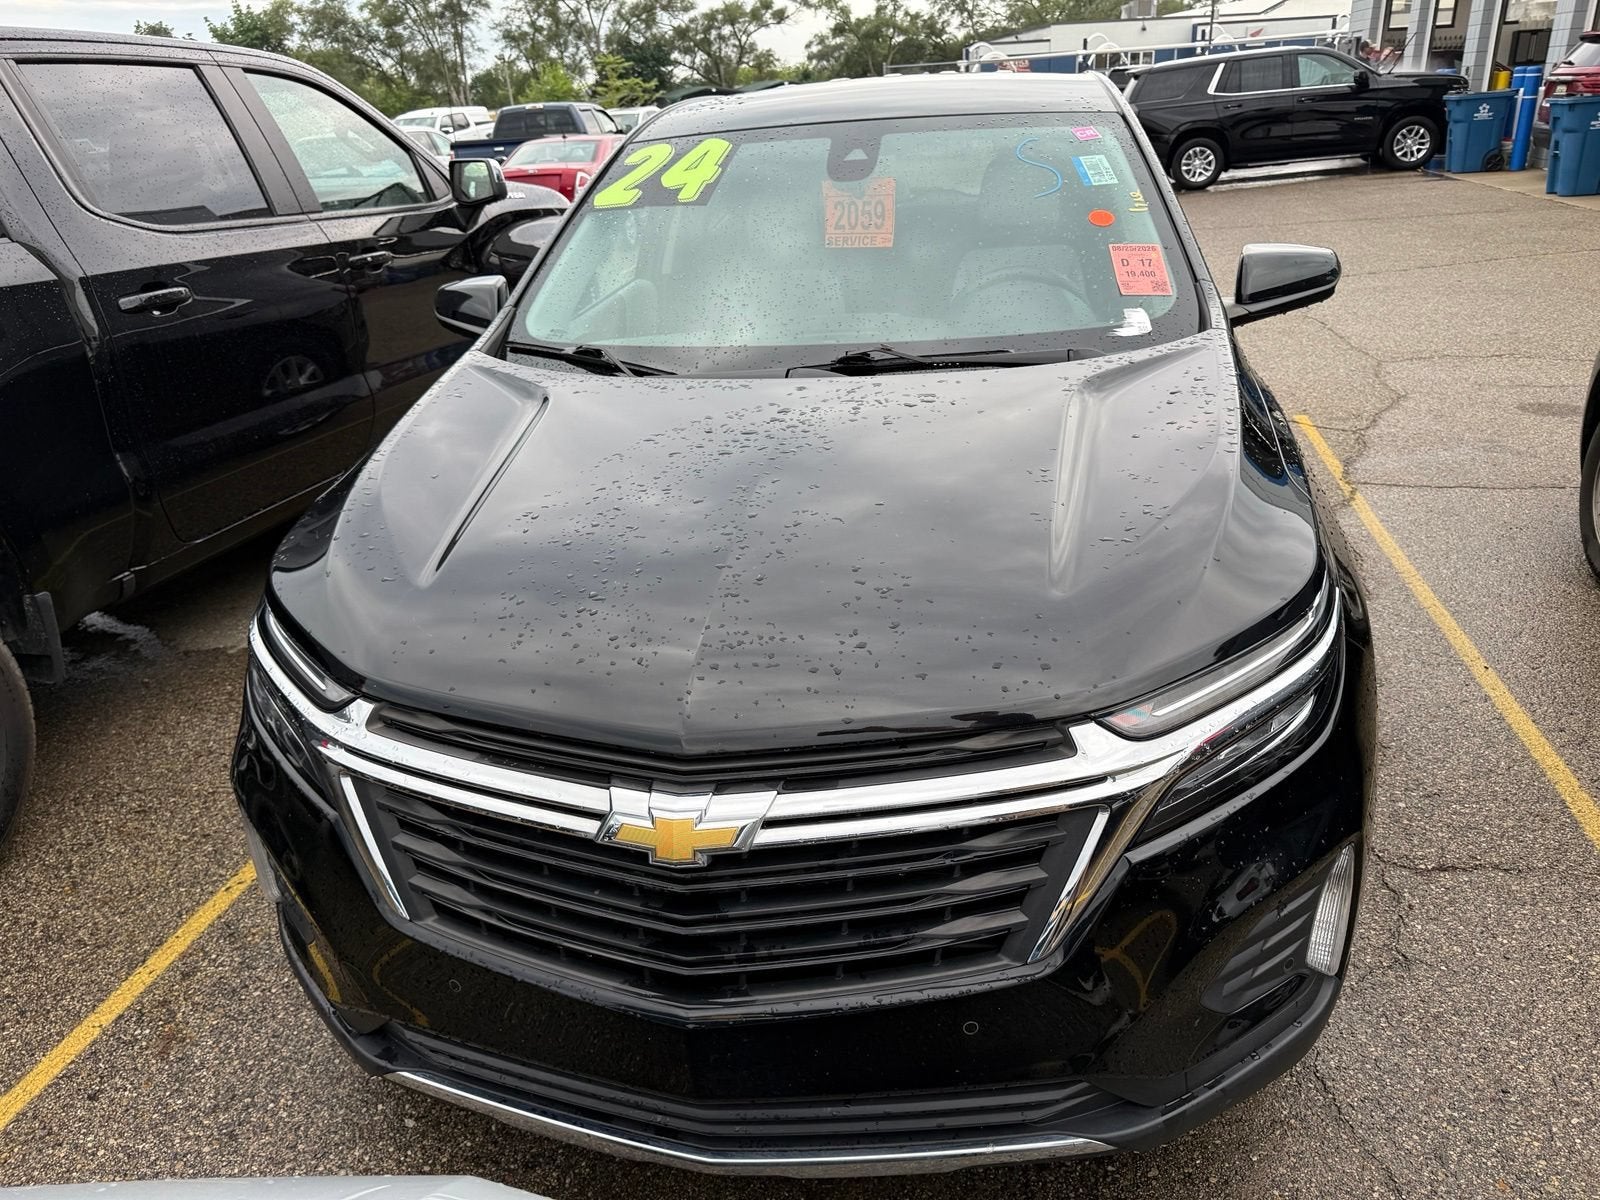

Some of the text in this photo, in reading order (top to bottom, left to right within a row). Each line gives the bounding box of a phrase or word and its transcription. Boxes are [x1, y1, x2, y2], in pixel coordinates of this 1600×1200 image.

[593, 138, 733, 209] 24
[833, 200, 886, 231] 2059
[826, 235, 878, 247] SERVICE
[1121, 258, 1153, 267] D 17
